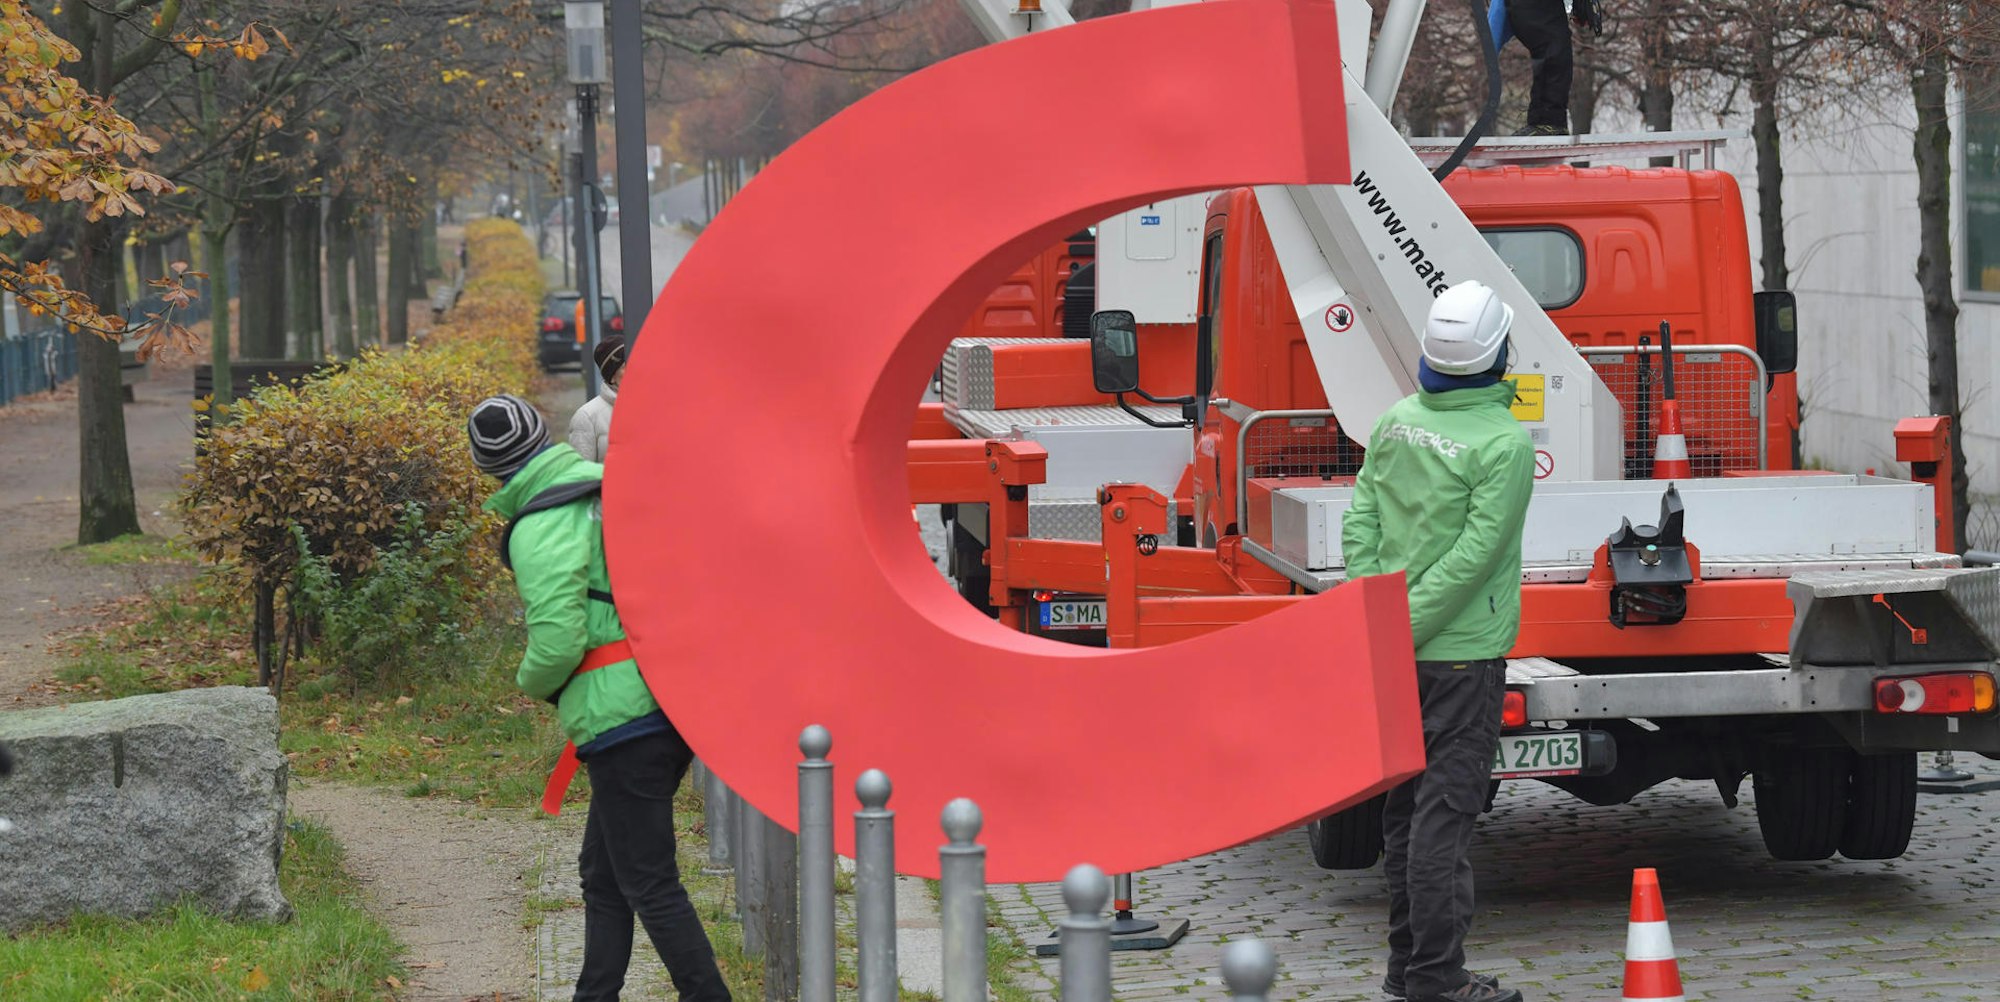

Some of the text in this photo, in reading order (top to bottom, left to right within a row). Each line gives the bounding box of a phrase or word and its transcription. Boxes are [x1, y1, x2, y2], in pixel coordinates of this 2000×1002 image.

[1380, 424, 1467, 457] GEENPEACE
[1052, 605, 1101, 622] S MA
[1514, 737, 1578, 768] 2703
